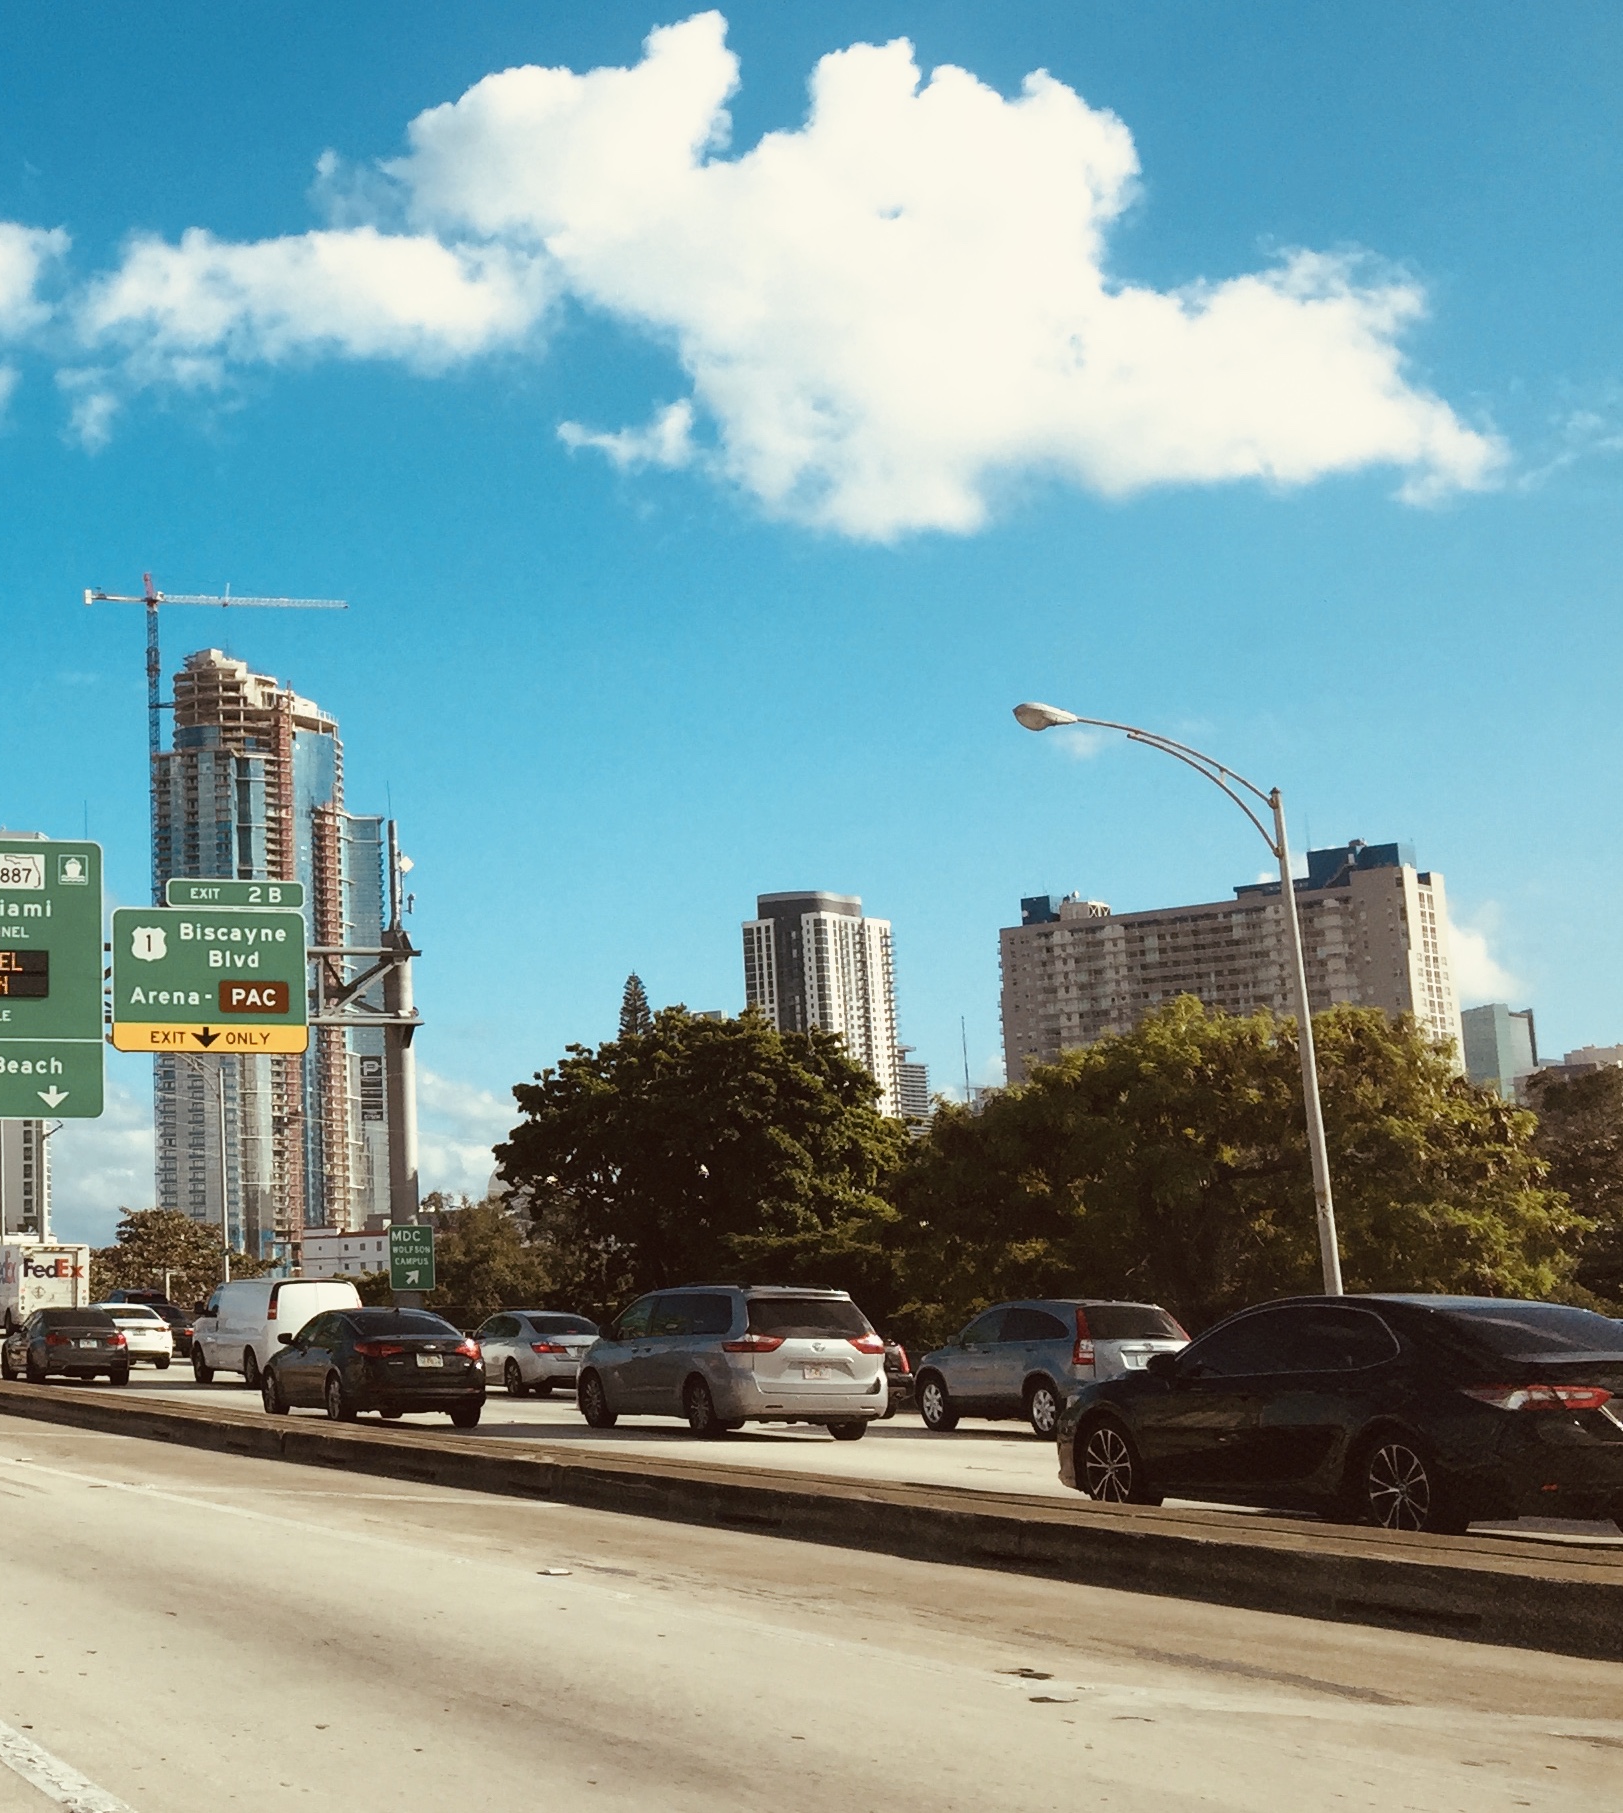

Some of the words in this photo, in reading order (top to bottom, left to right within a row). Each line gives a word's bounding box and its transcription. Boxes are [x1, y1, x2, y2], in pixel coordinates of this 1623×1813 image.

[0, 868, 33, 883] 887
[190, 887, 220, 900] EXIT
[179, 922, 287, 945] Biscayne
[146, 934, 151, 952] 1
[208, 950, 259, 968] Blvd
[231, 988, 276, 1006] PAC
[150, 1031, 186, 1044] EXIT
[226, 1032, 270, 1045] ONLY
[391, 1230, 421, 1242] MDC
[392, 1245, 431, 1254] WOLFSON
[23, 1258, 84, 1278] FedEx
[394, 1257, 429, 1265] CAMPUS
